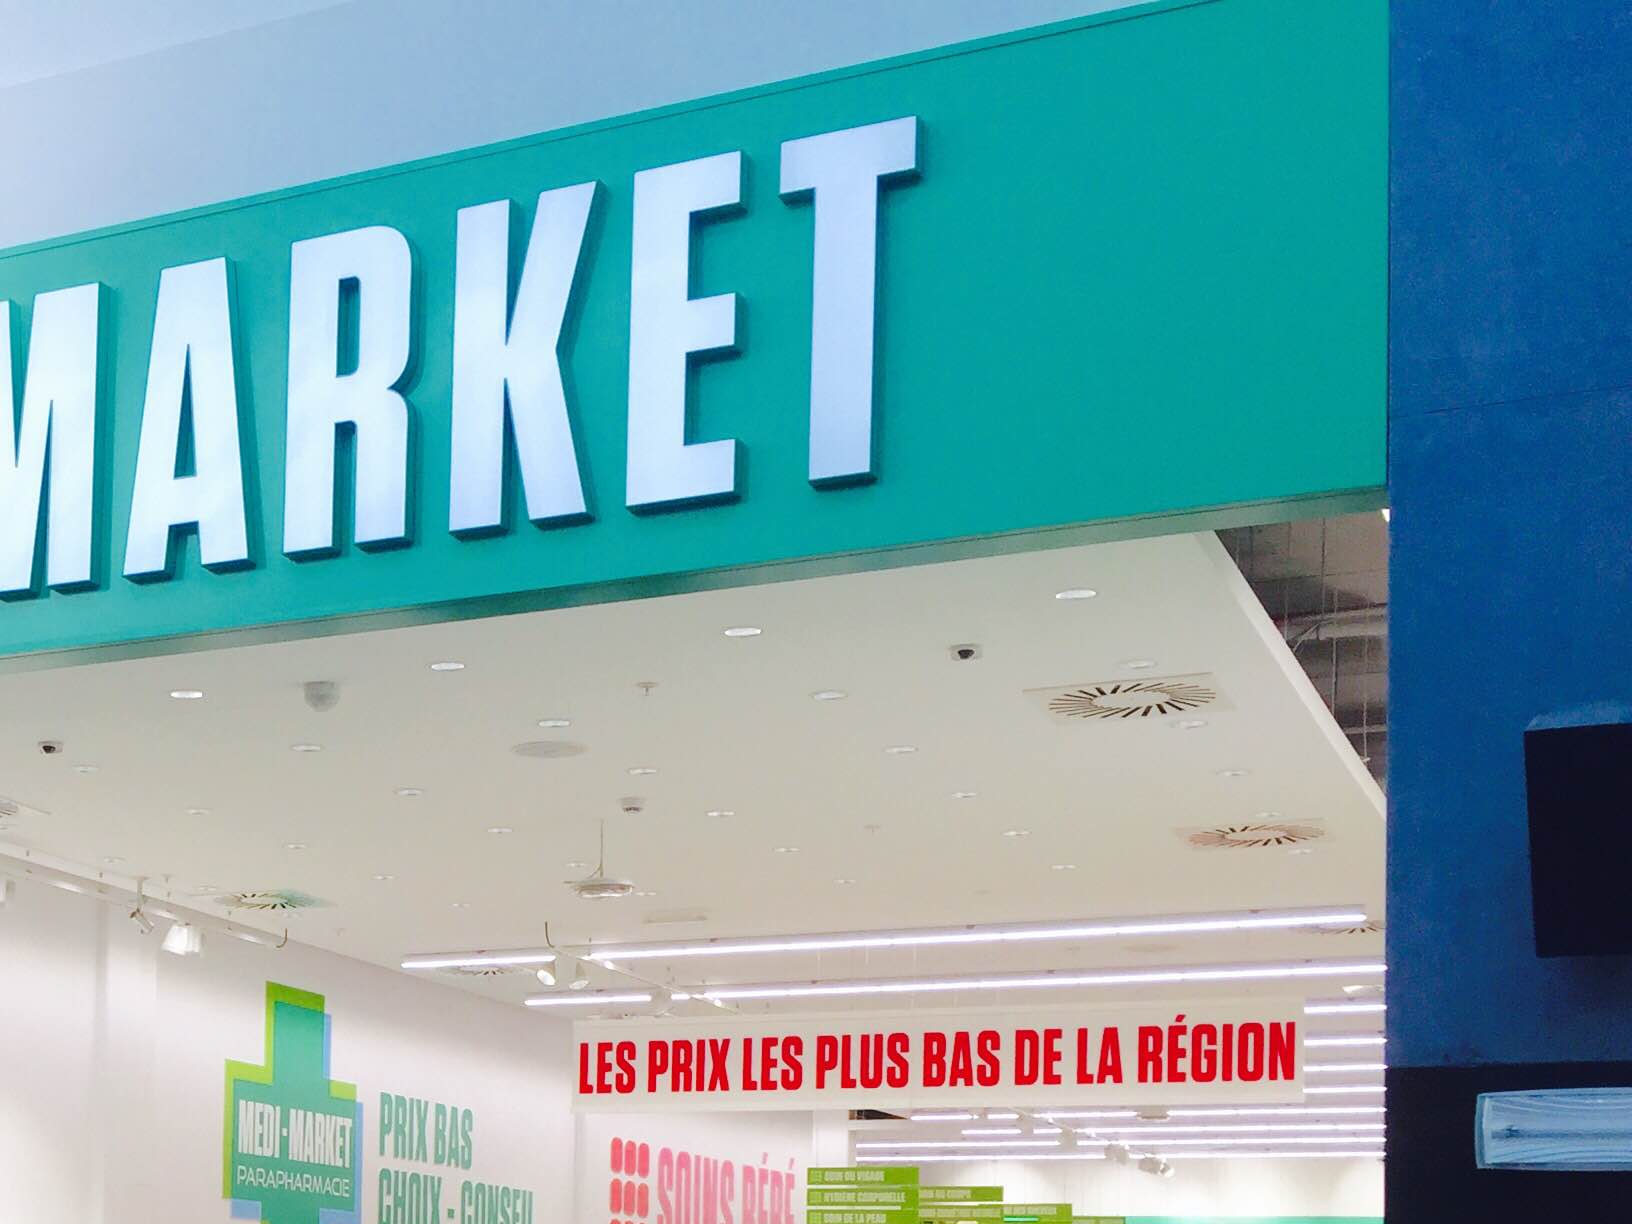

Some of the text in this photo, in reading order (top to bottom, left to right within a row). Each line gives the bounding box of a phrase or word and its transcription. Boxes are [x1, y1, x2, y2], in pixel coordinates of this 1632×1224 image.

[579, 1014, 1296, 1094] LES PRIX LES PLUS BAS DE LA RÉGION
[378, 1091, 473, 1170] PRIX BAS
[236, 1165, 351, 1198] PARAPHARMACIE
